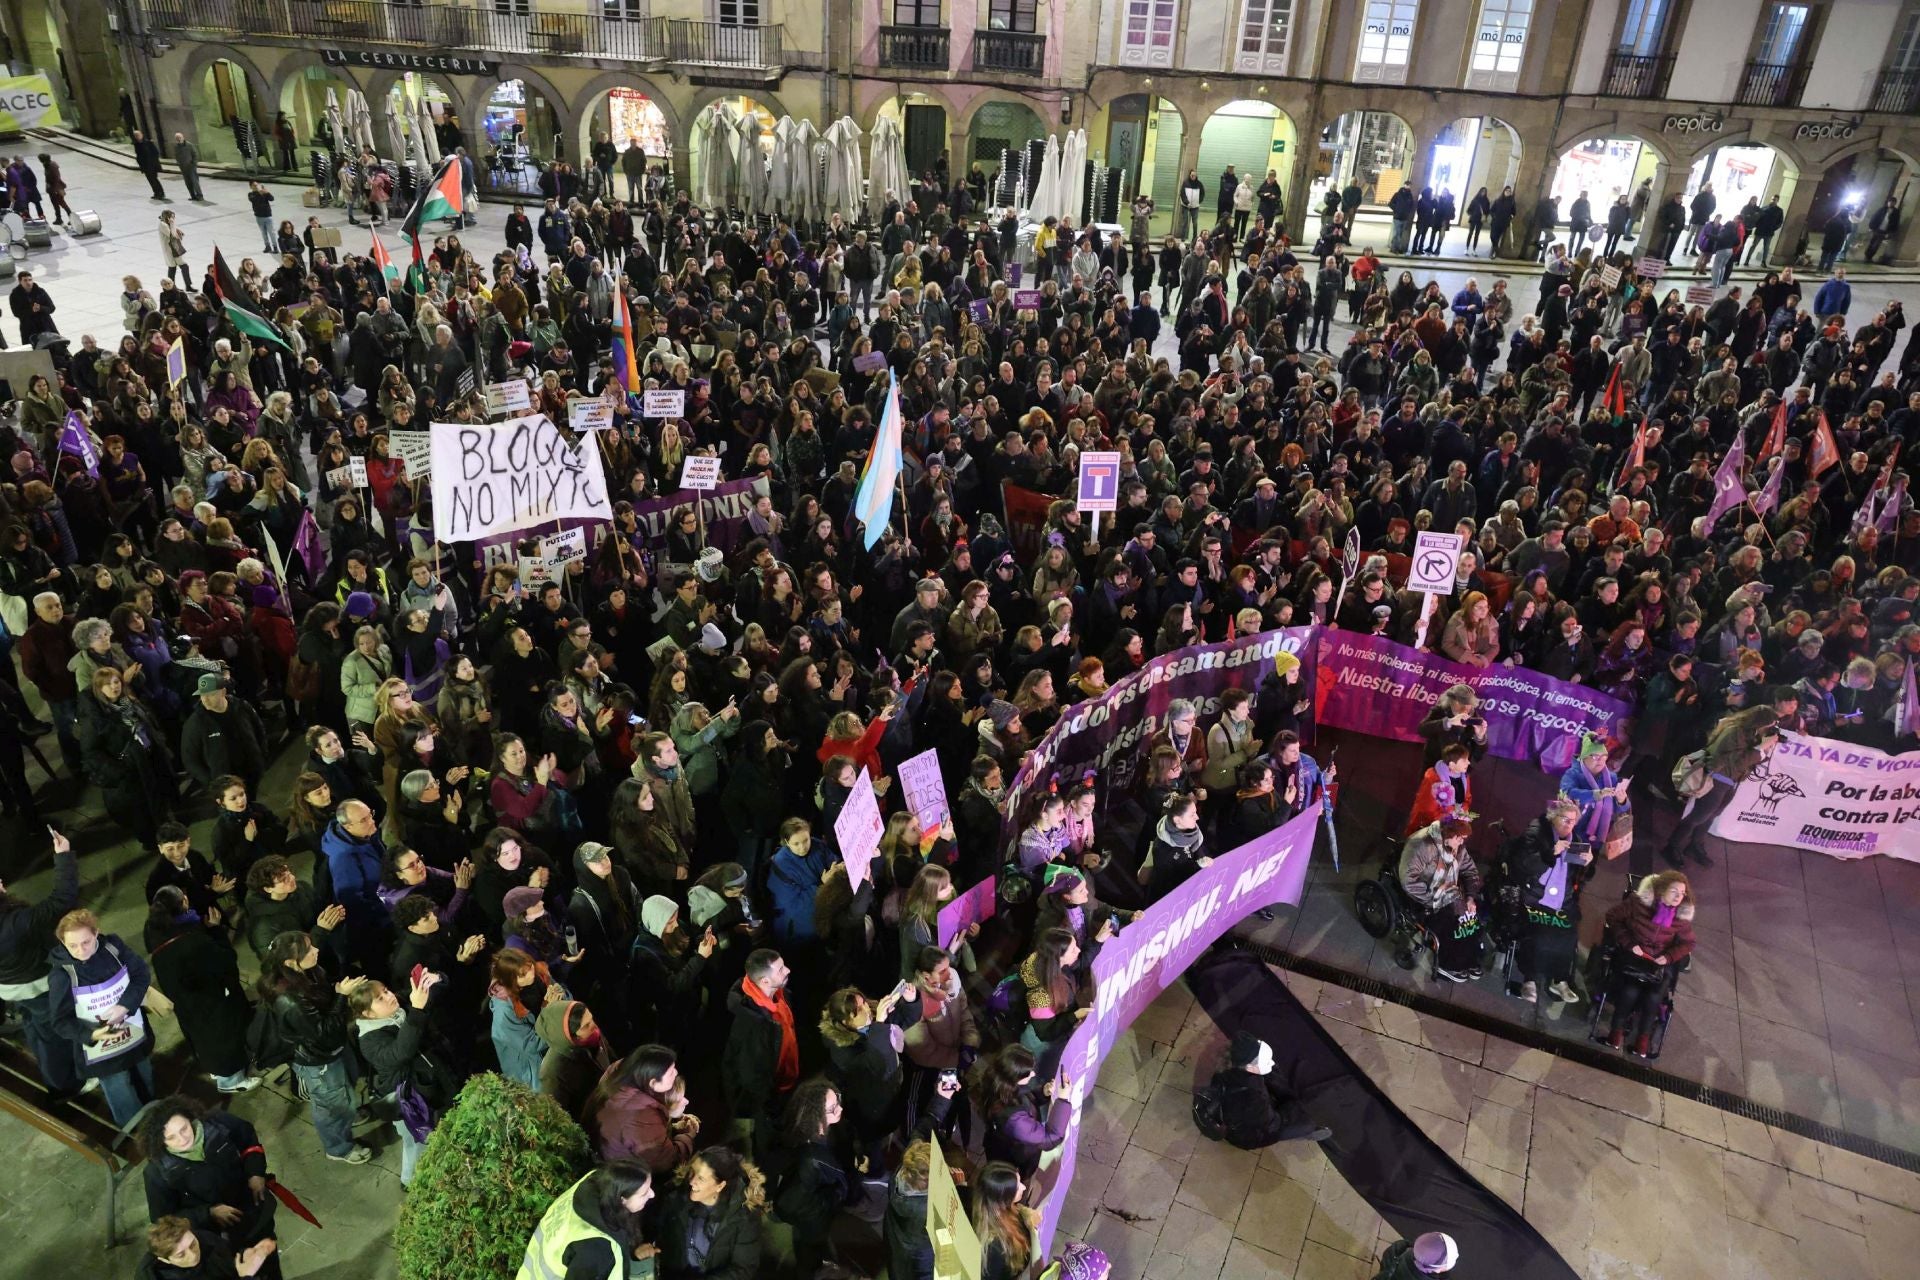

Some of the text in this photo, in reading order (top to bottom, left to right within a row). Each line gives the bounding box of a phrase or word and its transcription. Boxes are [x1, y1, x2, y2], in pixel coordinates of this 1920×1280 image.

[326, 50, 347, 62] LA
[0, 92, 51, 112] ACEC
[451, 482, 494, 535] NO
[545, 531, 576, 547] PUTERO
[1338, 643, 1354, 657] No
[1354, 647, 1376, 661] más
[1427, 667, 1440, 678] ni
[1468, 674, 1481, 685] ni
[1543, 688, 1554, 701] ni
[1553, 694, 1614, 722] emocional
[1338, 666, 1403, 697] Nuestra
[1498, 700, 1520, 715] se
[1820, 746, 1840, 763] YA
[1844, 754, 1873, 768] DE
[1824, 780, 1868, 800] Por
[1869, 784, 1889, 801] la
[1819, 807, 1889, 824] contra
[1799, 824, 1864, 842] IZQUIERDA
